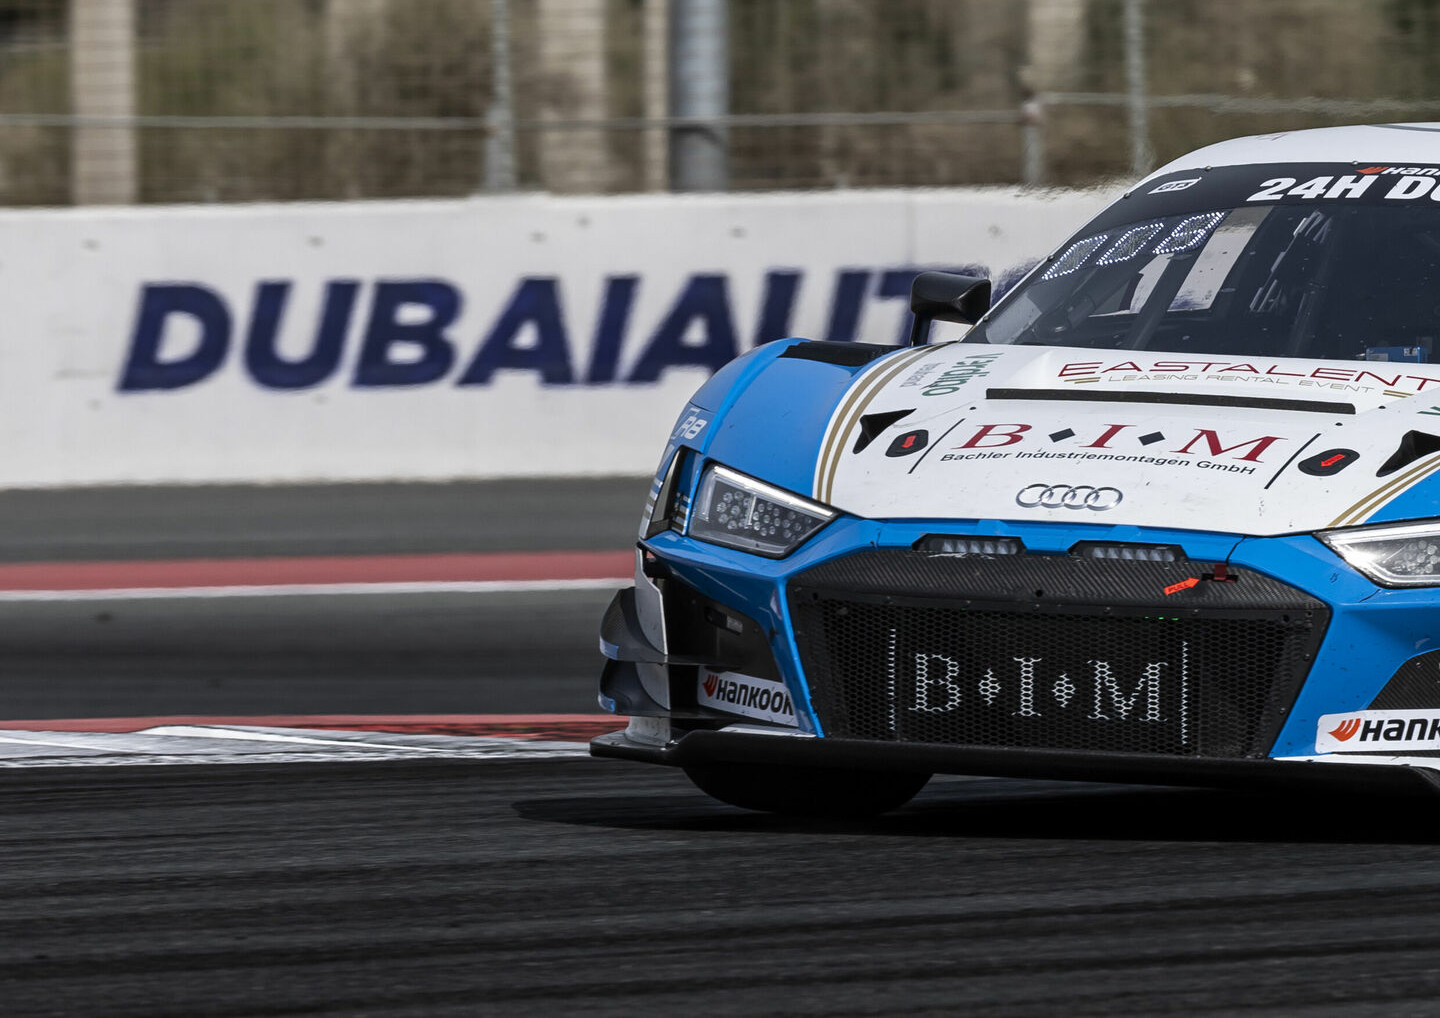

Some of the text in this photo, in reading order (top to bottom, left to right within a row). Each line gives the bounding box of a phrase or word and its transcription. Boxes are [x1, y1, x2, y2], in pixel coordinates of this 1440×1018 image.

[1246, 175, 1381, 202] 24H
[1108, 374, 1375, 393] LEASING RENTAL EVENT
[940, 449, 1257, 476] Bachler Industriemontagen GmbH
